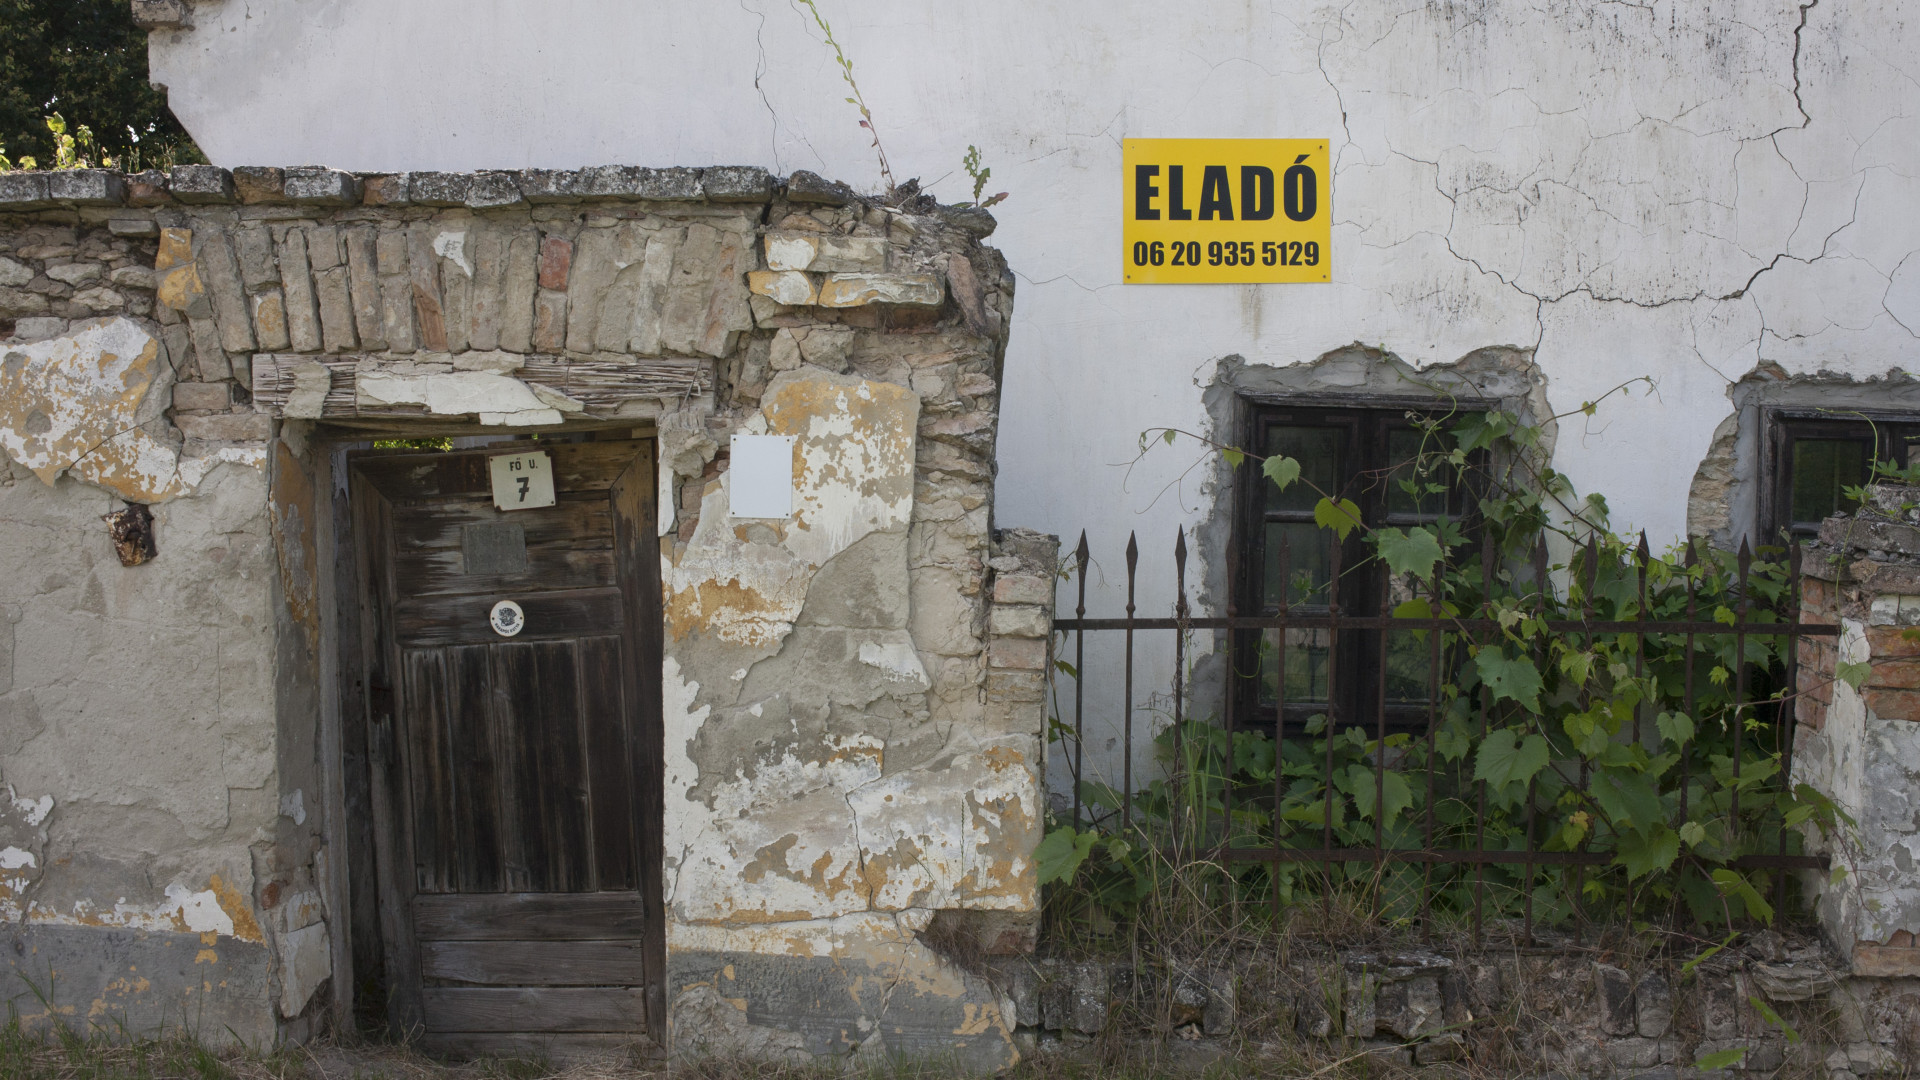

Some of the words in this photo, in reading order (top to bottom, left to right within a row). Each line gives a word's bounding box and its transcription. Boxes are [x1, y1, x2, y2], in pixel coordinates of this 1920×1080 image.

[1135, 154, 1317, 222] ELADÓ
[1133, 241, 1165, 267] 06
[1170, 241, 1201, 267] 20
[1208, 241, 1255, 267] 935
[1261, 241, 1320, 267] 5129
[528, 459, 538, 469] U.
[516, 476, 530, 502] 7
